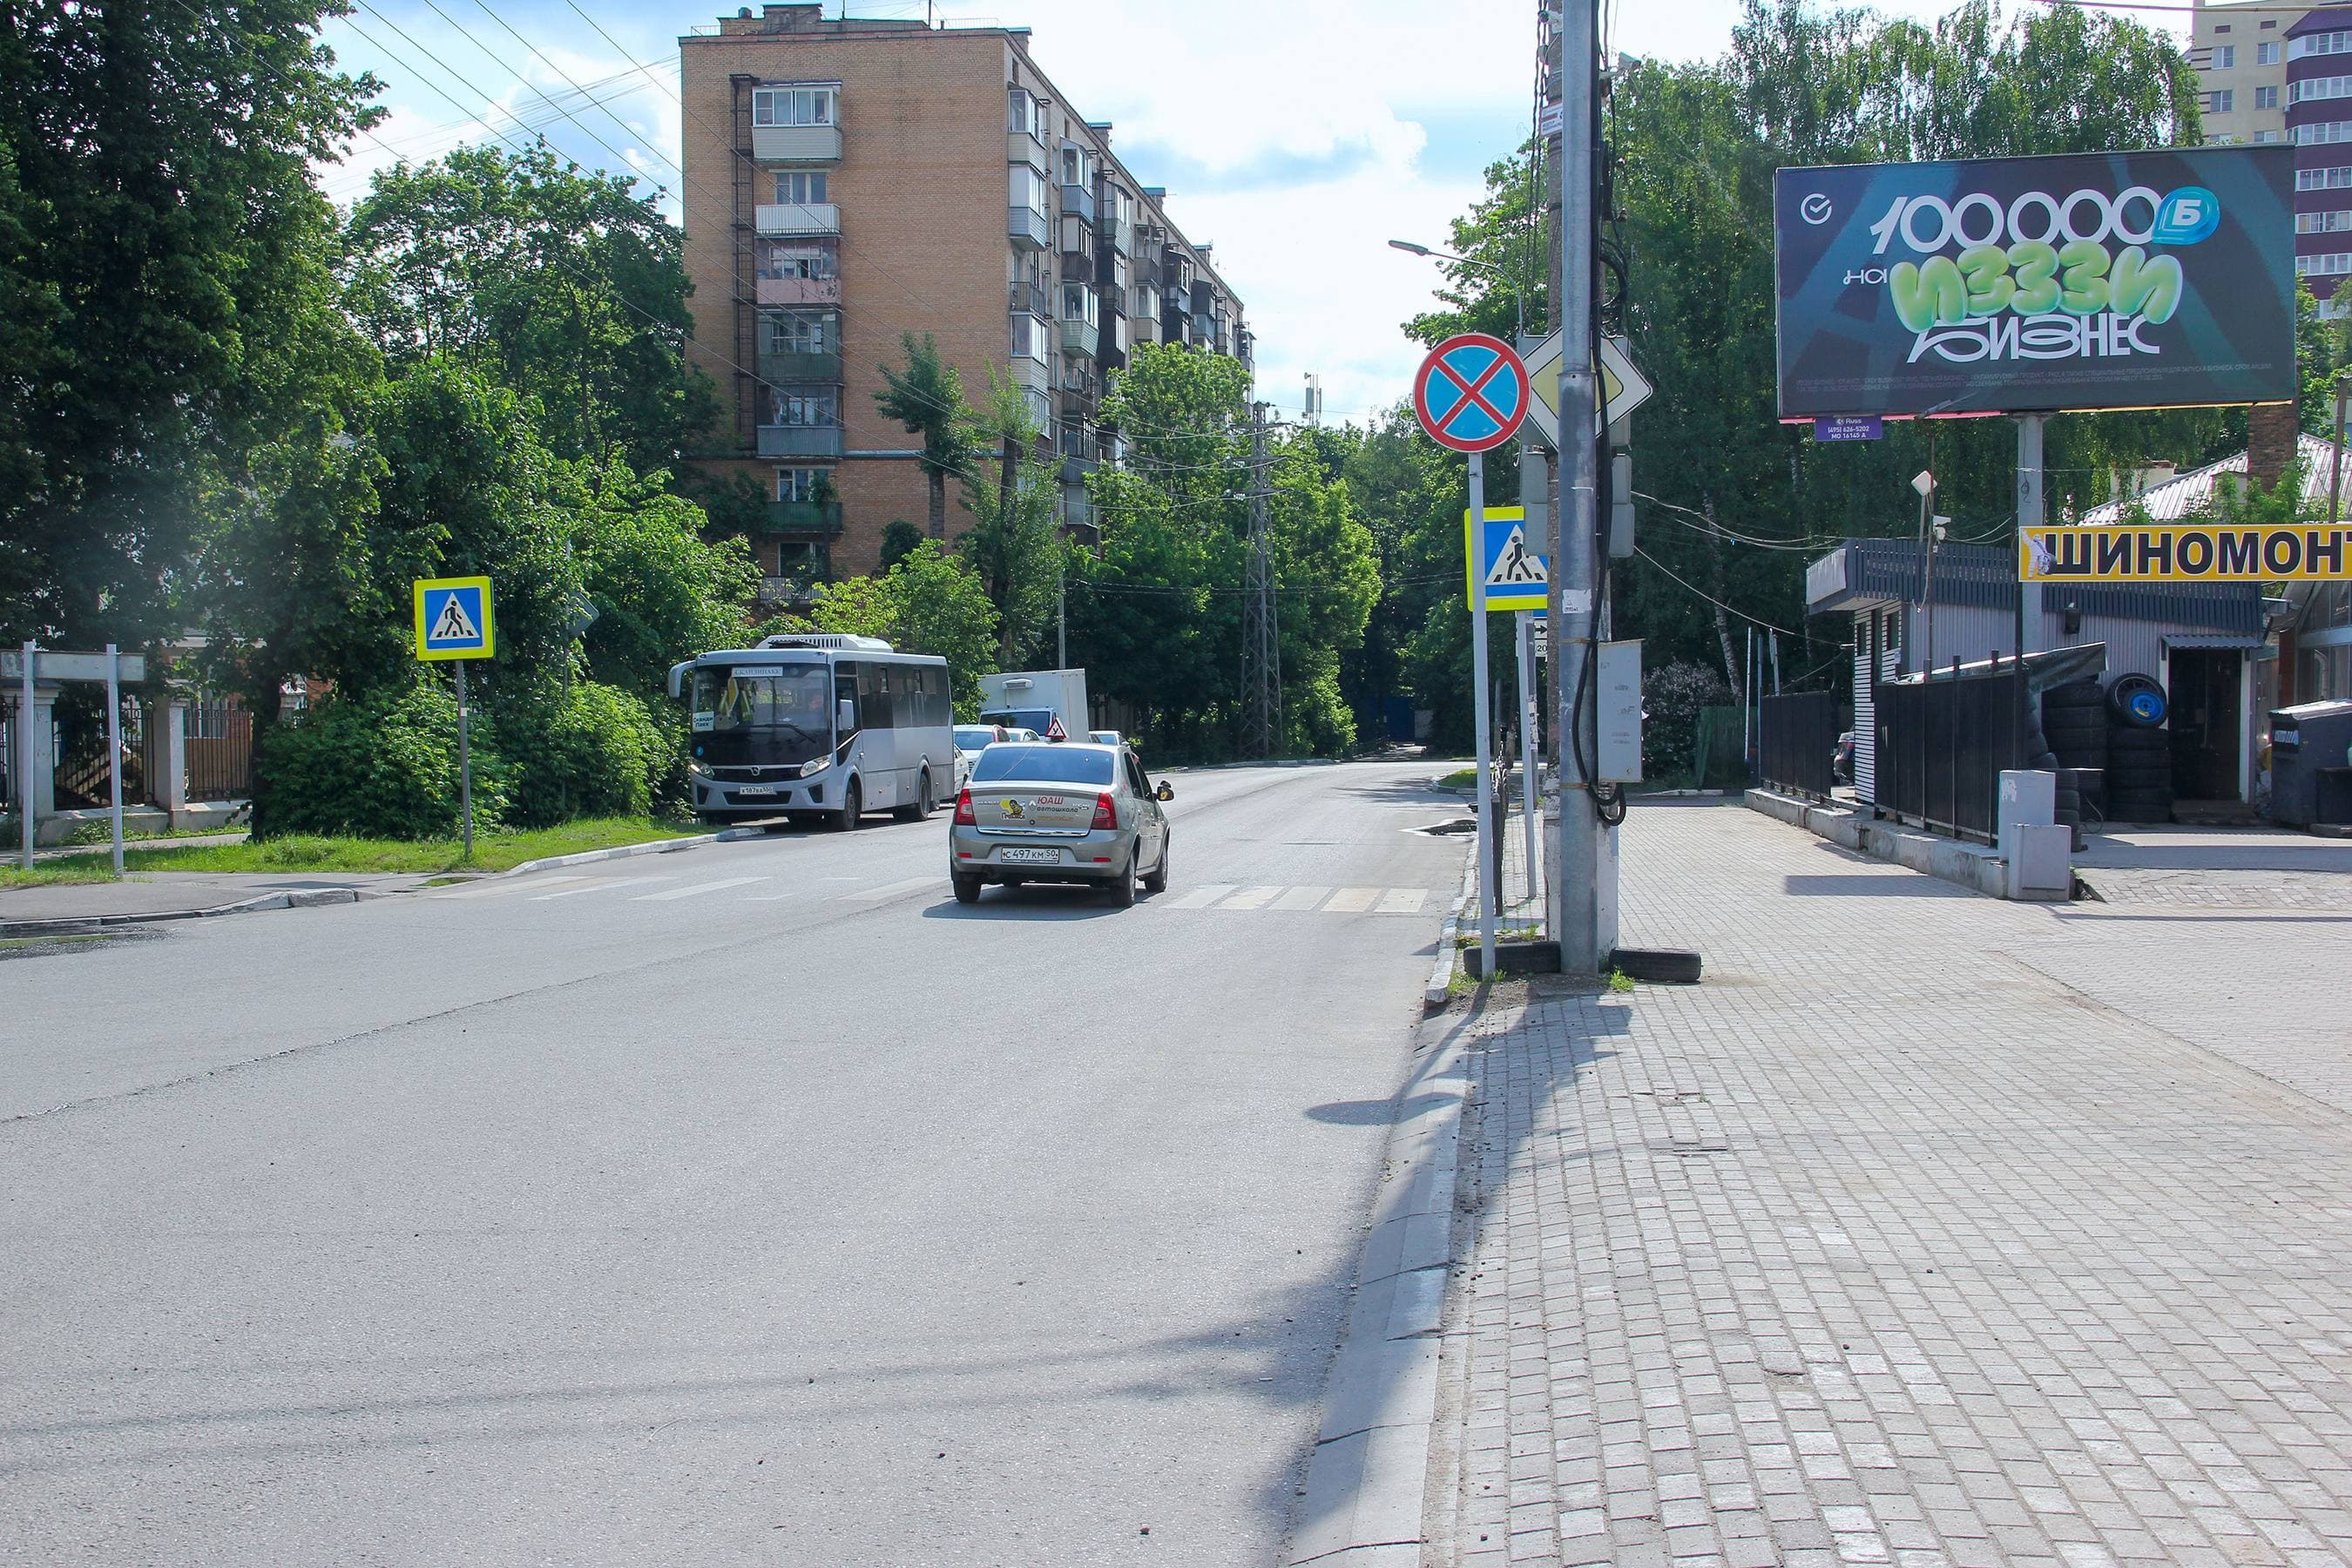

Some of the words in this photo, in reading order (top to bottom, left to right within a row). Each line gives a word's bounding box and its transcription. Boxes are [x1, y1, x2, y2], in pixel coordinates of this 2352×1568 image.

[1907, 313, 2159, 362] БИЗНЕС
[2044, 531, 2352, 575] ШИНОМОН
[1037, 796, 1064, 805] ЮАШ
